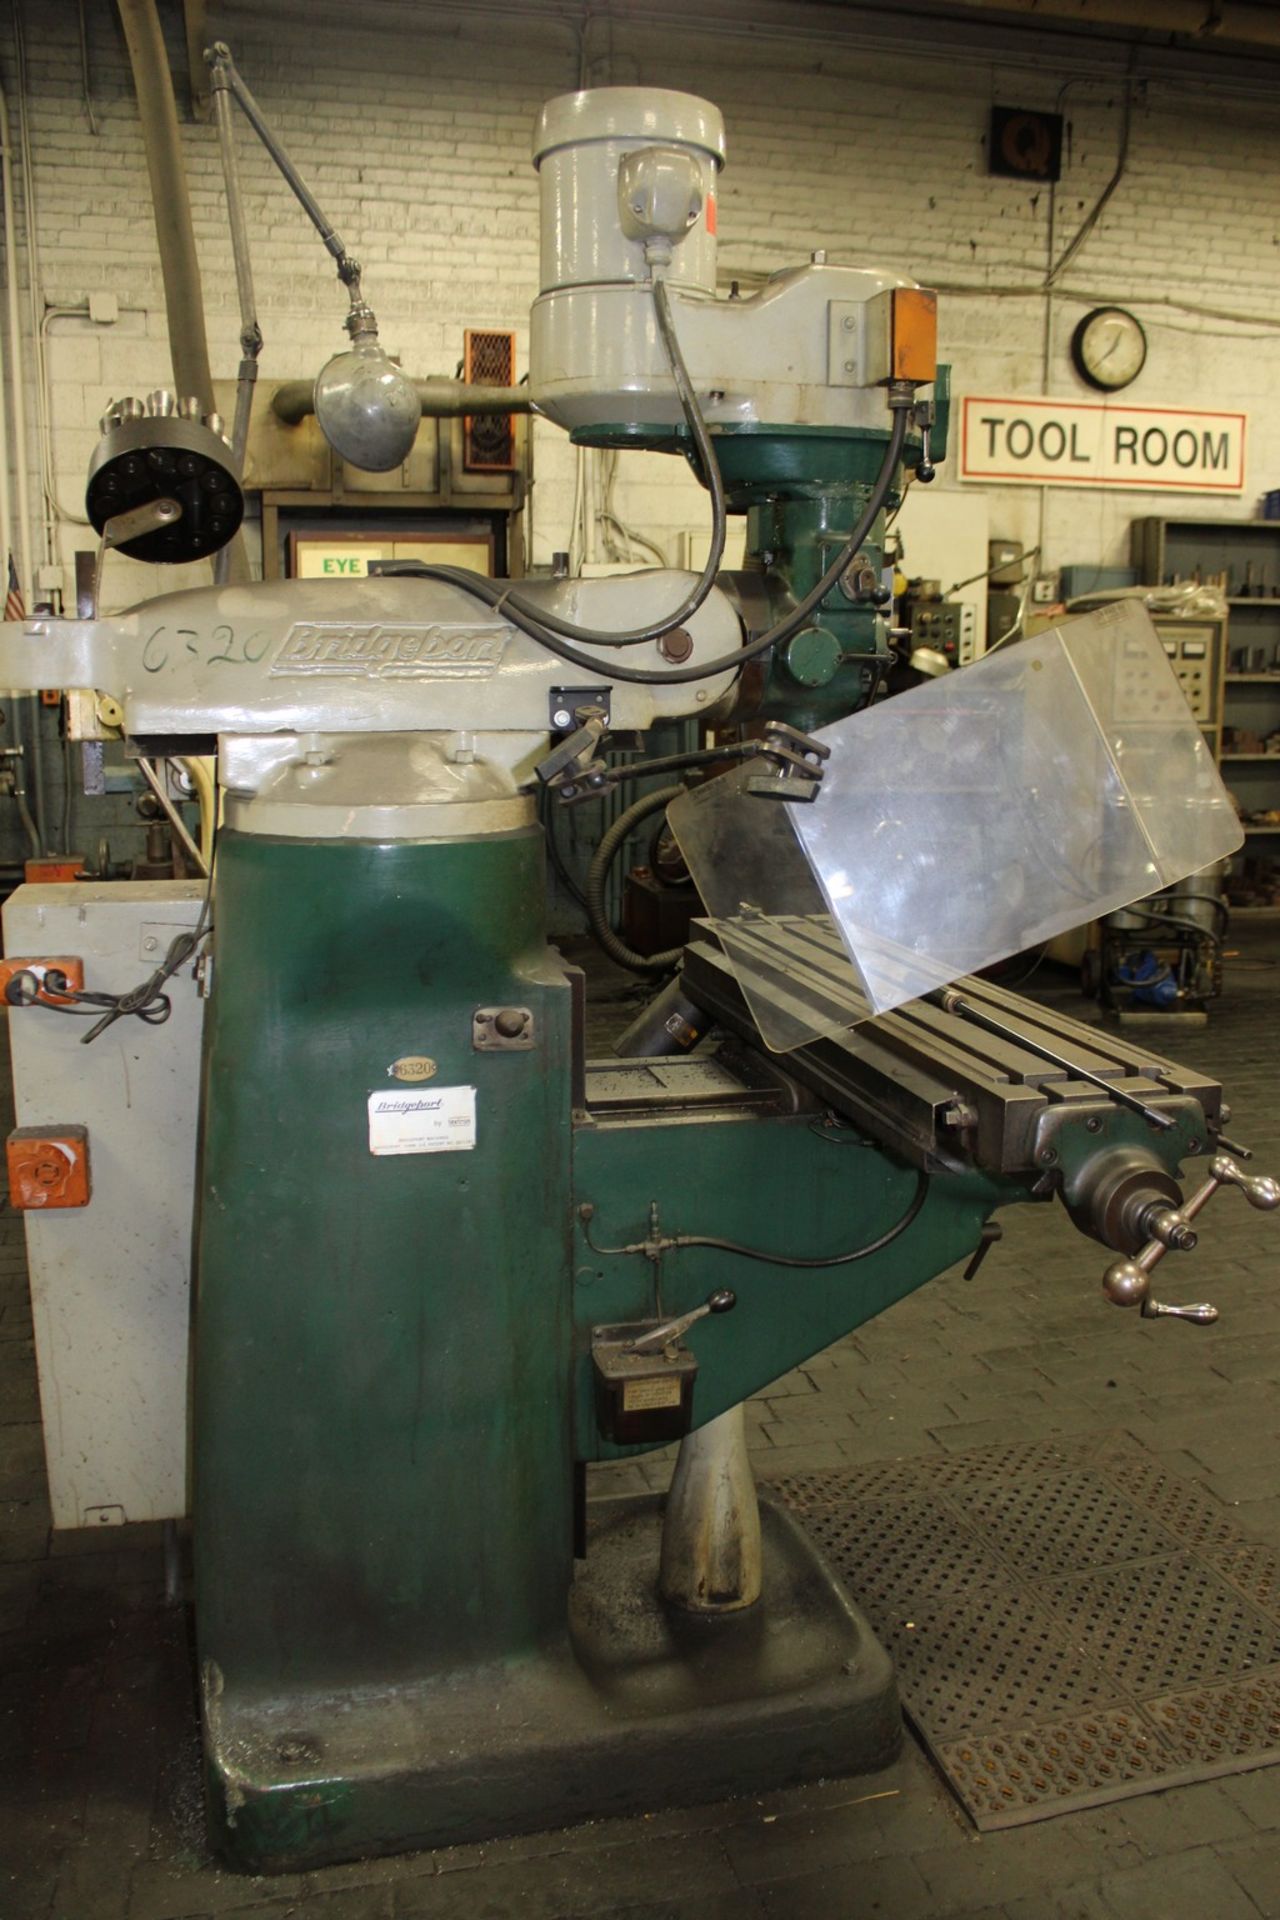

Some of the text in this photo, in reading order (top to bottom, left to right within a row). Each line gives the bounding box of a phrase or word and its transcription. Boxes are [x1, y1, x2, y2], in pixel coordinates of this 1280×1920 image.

[980, 418, 1229, 470] TOOL ROOM
[322, 558, 361, 573] EYE
[281, 624, 515, 674] Bridgeport
[400, 1062, 431, 1075] 6320
[375, 1099, 442, 1115] Bridgeport
